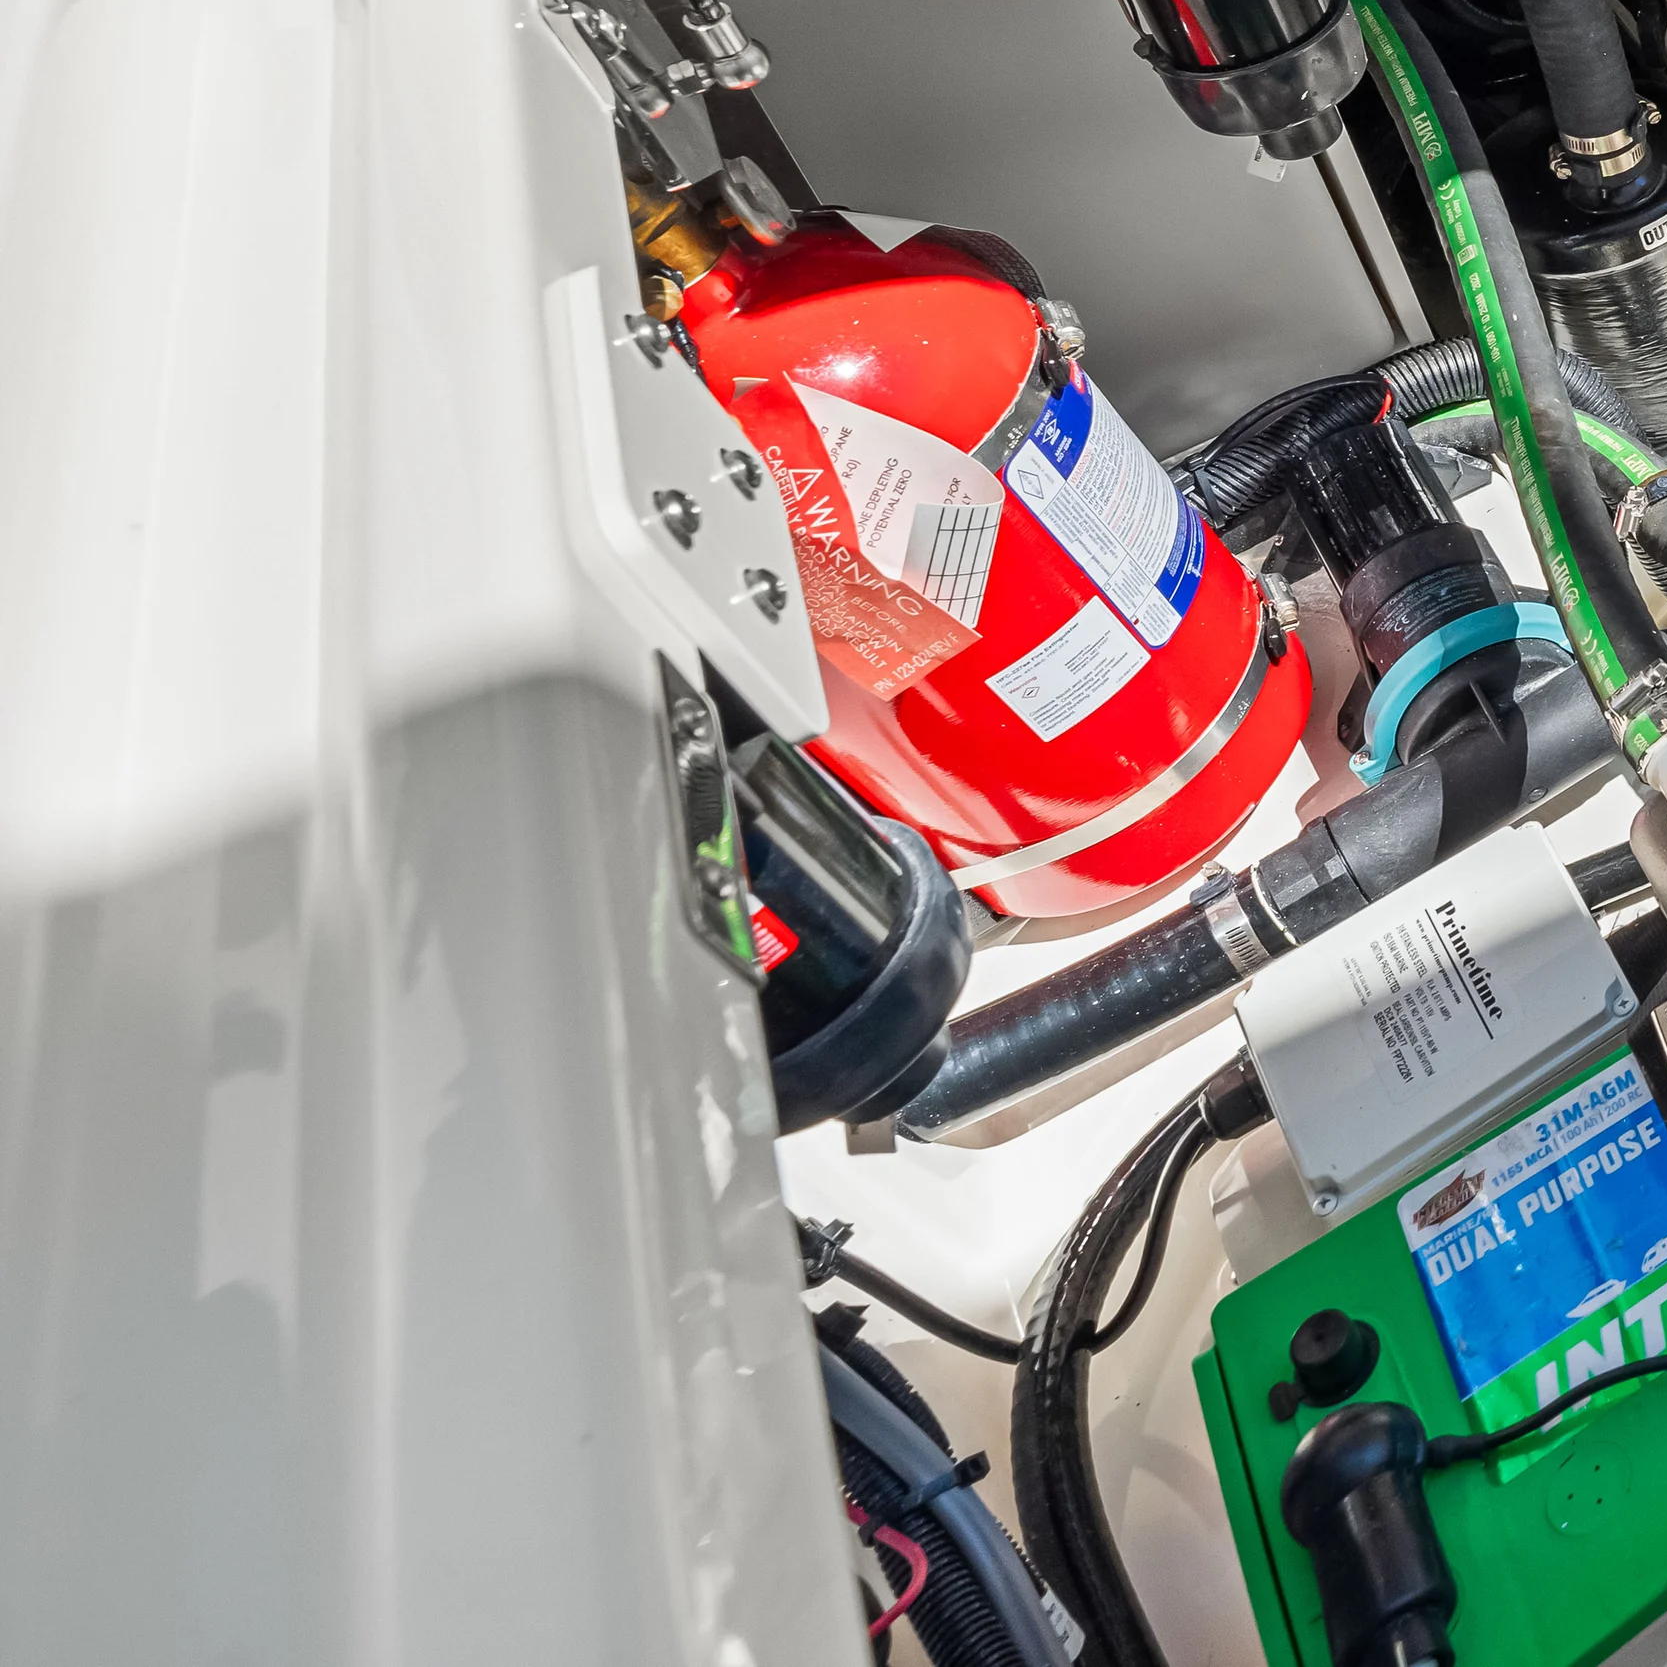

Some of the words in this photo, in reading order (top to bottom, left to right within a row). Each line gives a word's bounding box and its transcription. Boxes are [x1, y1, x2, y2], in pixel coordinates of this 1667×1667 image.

[1359, 5, 1384, 37] HARDWALL
[1376, 33, 1394, 56] WATER
[1386, 53, 1405, 78] MARINE
[1398, 77, 1419, 107] PREMIUM
[1410, 110, 1436, 143] MPI
[1437, 179, 1455, 201] CE
[1468, 271, 1482, 291] 2023
[1509, 415, 1527, 457] HARDWALL
[863, 455, 897, 510] DEPLETING
[945, 476, 961, 497] FOR
[1520, 456, 1535, 484] WATER
[764, 446, 807, 530] CAREFULLY
[1527, 483, 1545, 515] MARINE
[865, 493, 899, 548] POTENTIAL
[891, 467, 912, 495] ZERO
[1537, 514, 1556, 547] PREMIUM
[805, 495, 924, 618] WARNING
[1547, 551, 1573, 588] MPI
[1549, 551, 1573, 587] MPI
[851, 589, 906, 635] BEFORE
[841, 625, 888, 670] RESULT
[1577, 628, 1600, 655] CE
[891, 647, 933, 682] 123-024
[1008, 673, 1037, 696] Warning
[1376, 959, 1402, 994] PROTECTED
[1390, 950, 1409, 974] MARINE
[1411, 958, 1429, 978] STEEL
[1432, 899, 1512, 1023] Primetime
[1390, 1000, 1404, 1017] SEAL
[1401, 992, 1416, 1009] PART
[1371, 1011, 1392, 1038] SERIAL
[1531, 1069, 1637, 1143] 31M-AGM
[1489, 1159, 1525, 1187] 1155
[1522, 1142, 1553, 1167] MCA
[1558, 1124, 1582, 1144] 100
[1579, 1113, 1599, 1131] Ah
[1602, 1094, 1627, 1115] 200
[1625, 1086, 1643, 1102] RC
[1420, 1212, 1516, 1286] DUAL
[1512, 1117, 1662, 1228] PURPOSE
